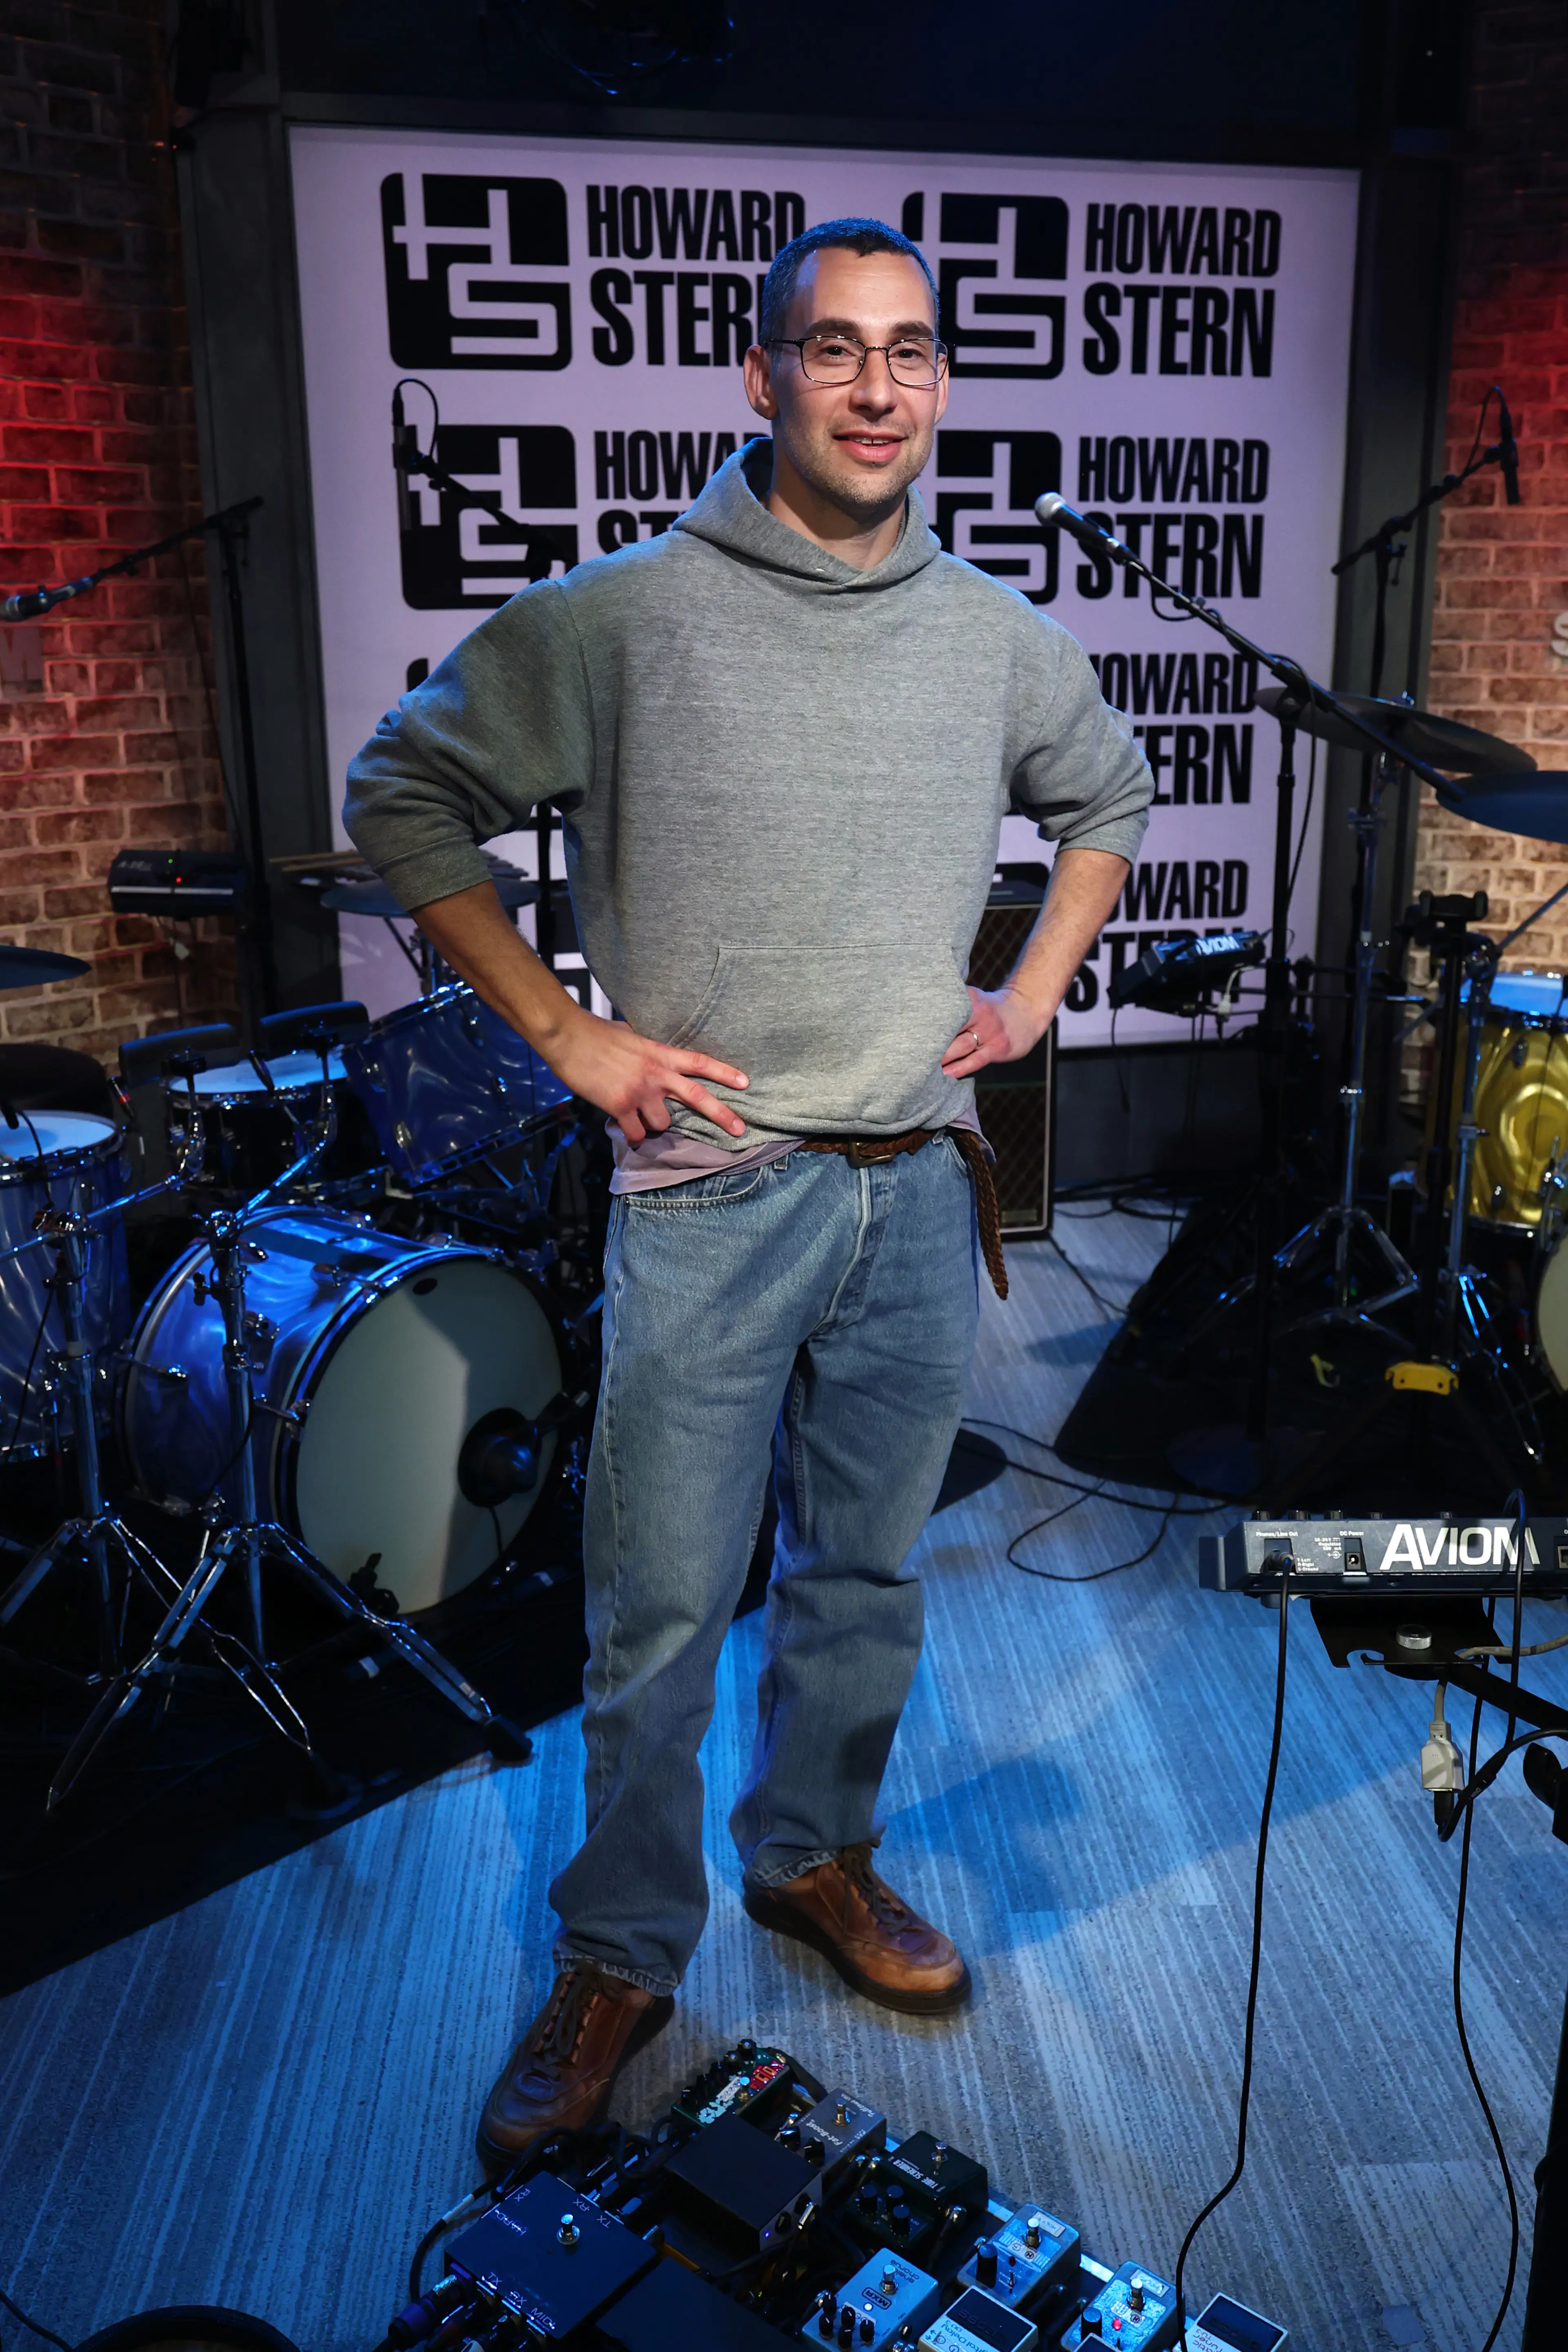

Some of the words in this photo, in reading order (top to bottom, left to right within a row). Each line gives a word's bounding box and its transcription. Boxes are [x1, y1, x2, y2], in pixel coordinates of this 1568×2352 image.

[586, 185, 806, 261] HOWARD
[1085, 203, 1282, 277] HOWARD
[590, 268, 765, 367] STER
[1082, 281, 1275, 377] STERN
[594, 430, 771, 501] HOW
[1078, 435, 1270, 503] HOWARD
[1076, 510, 1264, 599] STERN
[1133, 724, 1254, 805] ERN
[1108, 859, 1248, 924] WARD
[1380, 1524, 1541, 1570] AVIOM
[806, 2122, 843, 2146] Fat-Boost
[893, 2159, 924, 2179] SCREAMER
[921, 2176, 939, 2189] TUBE
[513, 2188, 531, 2203] RX
[572, 2198, 590, 2212] RX
[596, 2214, 611, 2229] TX
[488, 2272, 503, 2286] TX
[890, 2259, 920, 2280] chorus
[894, 2267, 915, 2283] anal
[510, 2291, 528, 2305] RX
[866, 2289, 889, 2307] MXR
[531, 2307, 556, 2330] MIDI
[941, 2323, 967, 2344] Delay
